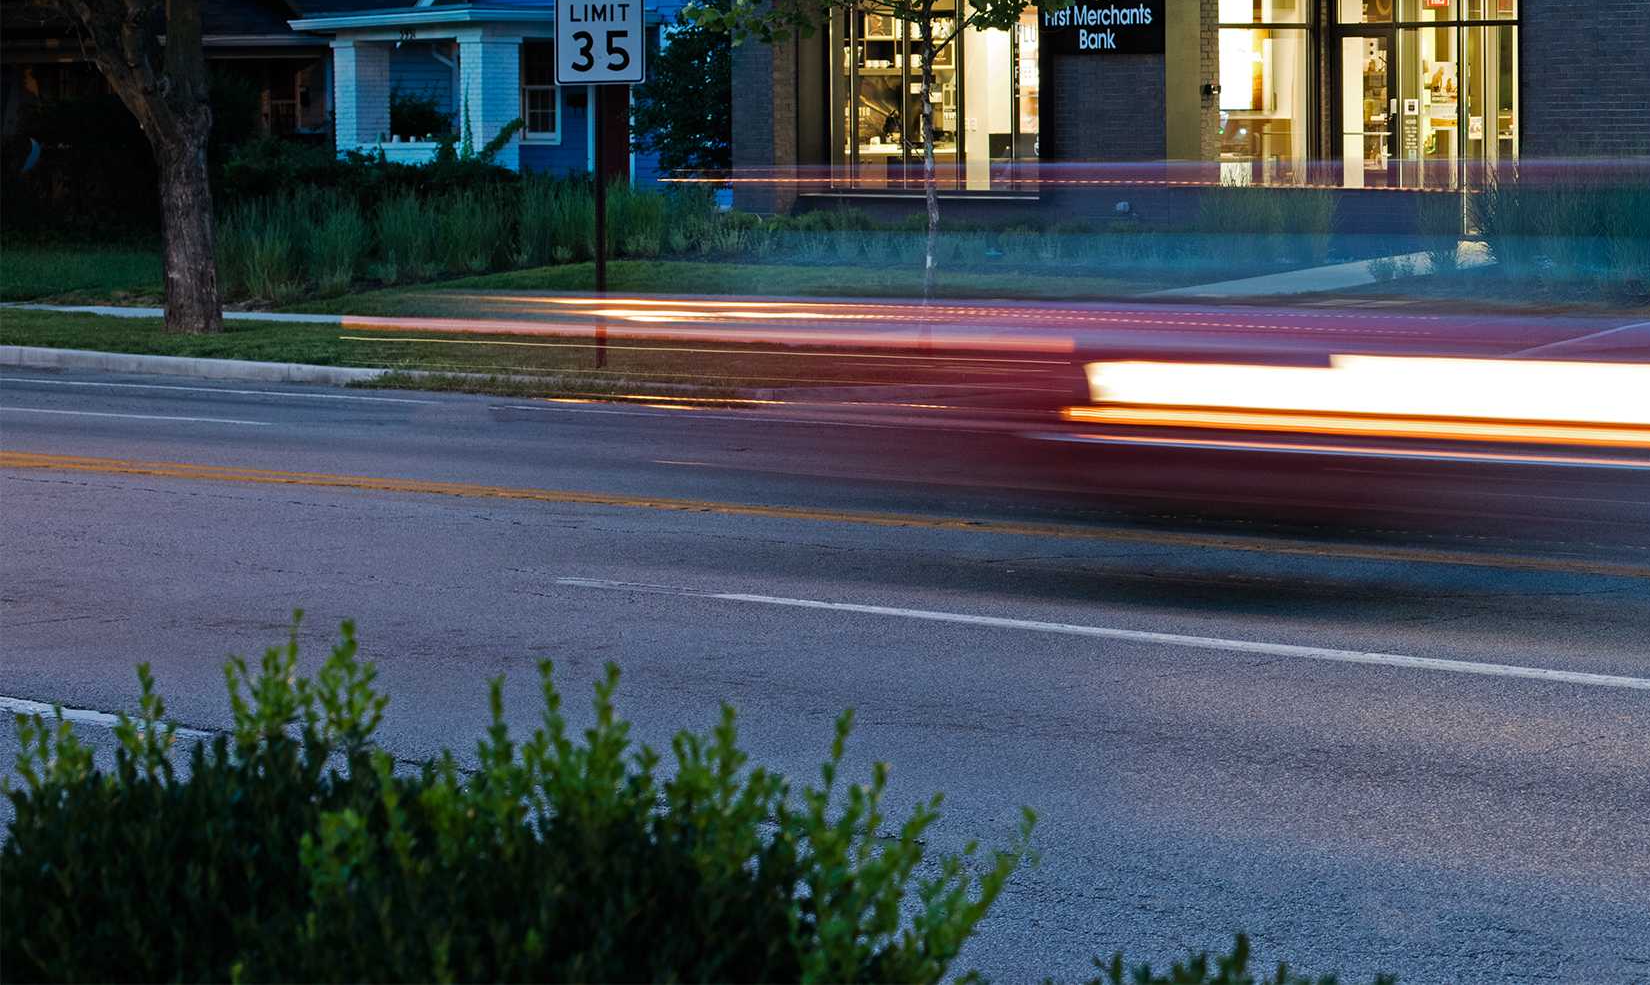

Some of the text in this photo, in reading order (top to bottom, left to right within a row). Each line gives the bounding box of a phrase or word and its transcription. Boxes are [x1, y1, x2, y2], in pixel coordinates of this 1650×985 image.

[570, 3, 630, 22] LIMIT
[1074, 3, 1153, 26] Merchants
[1079, 28, 1116, 50] Bank
[571, 30, 630, 72] 35
